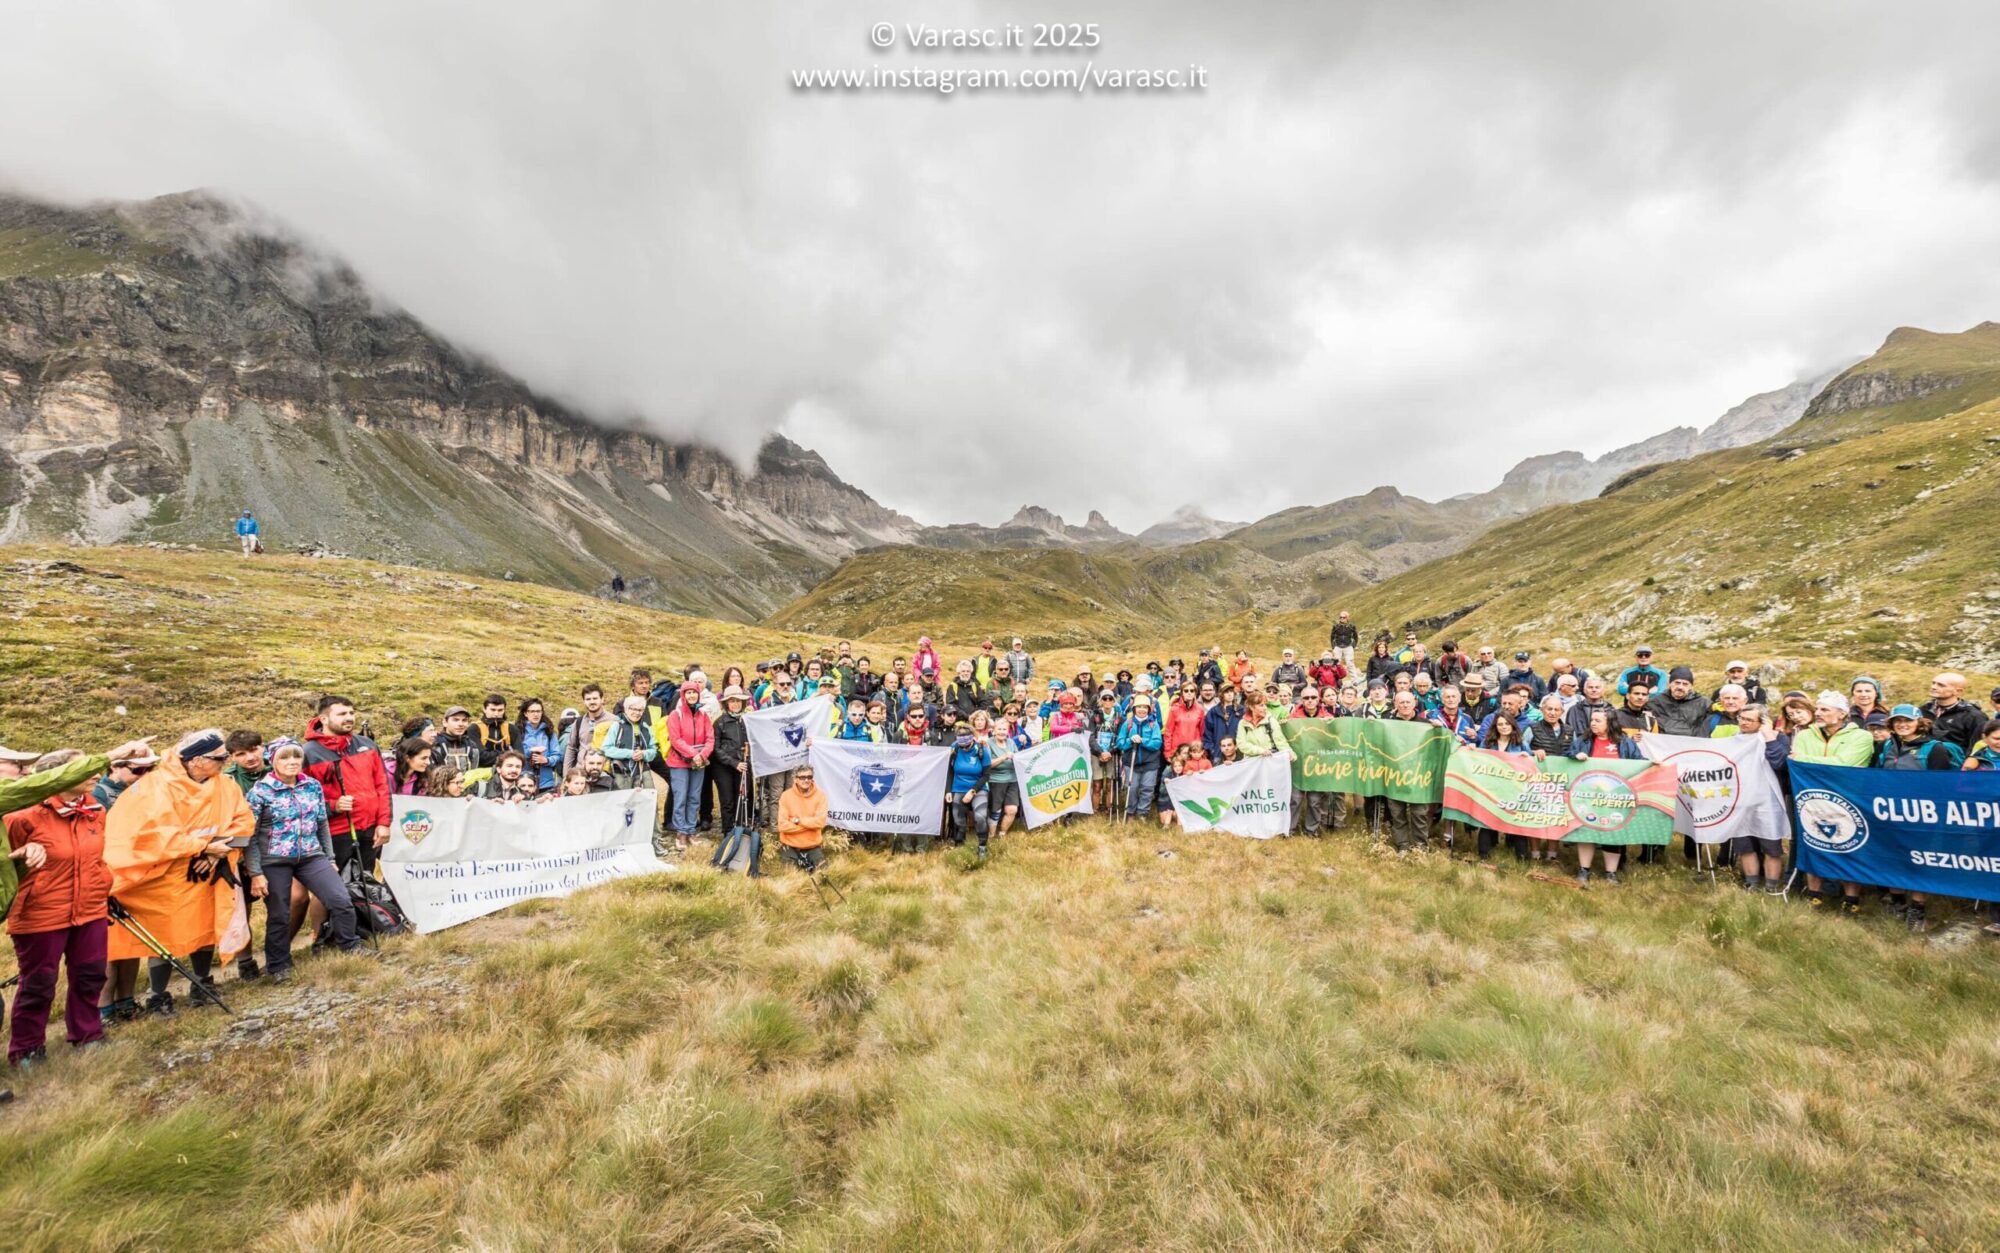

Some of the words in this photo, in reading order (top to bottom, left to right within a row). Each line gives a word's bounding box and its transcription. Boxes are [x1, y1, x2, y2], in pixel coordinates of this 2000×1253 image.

[1031, 769, 1087, 795] CONSERVATION
[1303, 755, 1354, 780] Cime
[1358, 759, 1433, 788] Bianche
[1471, 764, 1516, 780] VALLE
[1049, 782, 1081, 809] Key
[1517, 793, 1565, 805] GIUSTA
[1524, 783, 1566, 794] VERDE
[1497, 800, 1566, 815] SOLIDALE
[1592, 798, 1636, 809] APERTA
[1832, 796, 1864, 828] ITALIANO
[1873, 797, 1939, 824] CLUB
[1946, 800, 2000, 828] ALPI
[827, 810, 863, 822] SEZIONE
[866, 812, 875, 822] DI
[877, 812, 921, 824] INVERUNO
[1513, 812, 1569, 827] APERTA
[405, 861, 465, 880] Società
[473, 851, 580, 876] Escursionisti
[1910, 850, 2000, 873] SEZIONE
[451, 888, 468, 904] in
[474, 882, 554, 901] cammino
